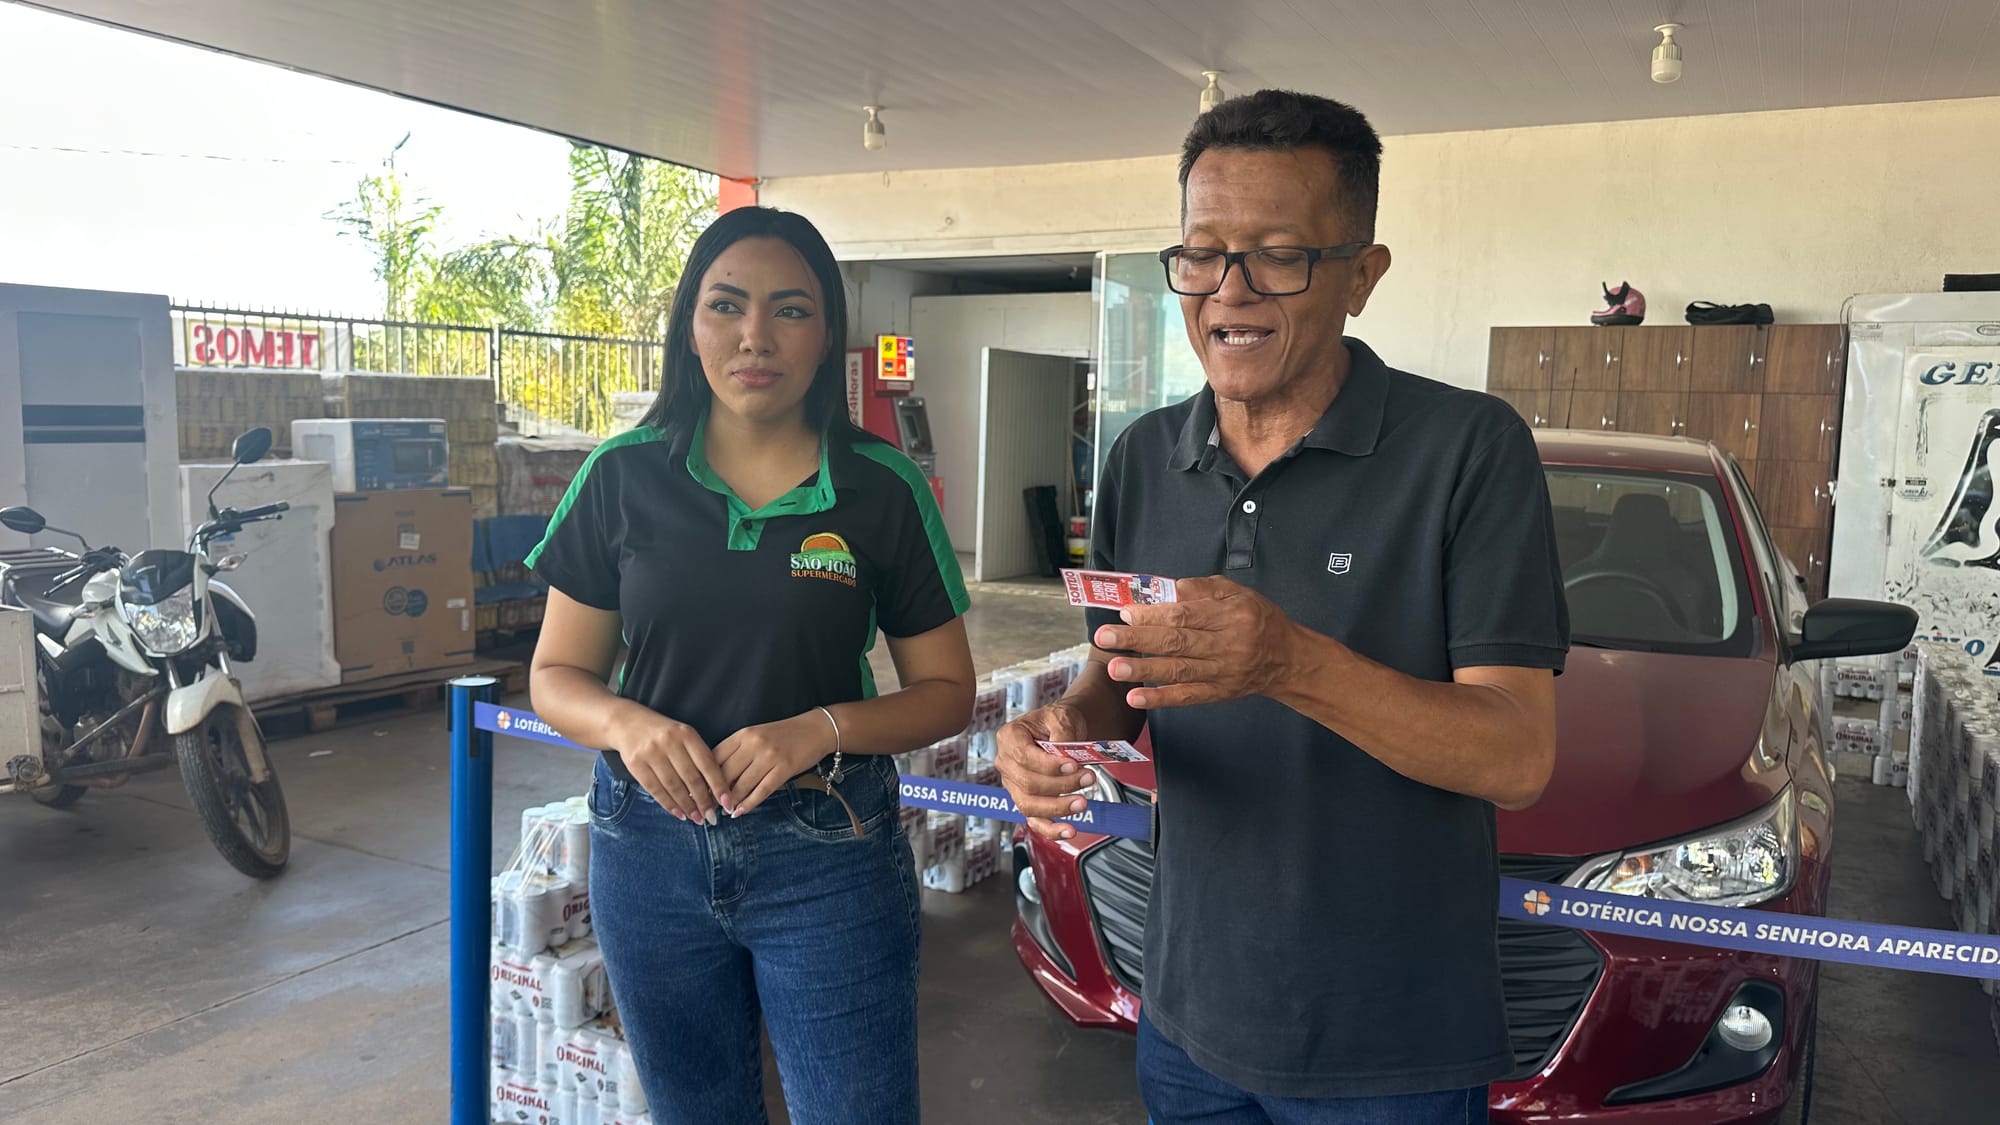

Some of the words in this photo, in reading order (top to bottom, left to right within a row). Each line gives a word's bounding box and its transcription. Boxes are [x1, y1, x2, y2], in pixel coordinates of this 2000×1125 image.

[1919, 361, 2000, 385] GE
[387, 553, 438, 567] ATLAS
[790, 553, 823, 570] SÃO
[825, 559, 857, 579] JOÃO
[791, 569, 857, 588] SUPERMERCADO
[1090, 580, 1106, 602] CARRO
[1104, 582, 1121, 603] ZERO
[940, 790, 1009, 813] SENHORA
[1560, 899, 1663, 927] LOTÉRICA
[1669, 914, 1748, 937] NOSSA
[1754, 923, 1870, 951] SENHORA
[1876, 938, 2000, 964] APARECID
[491, 964, 543, 992] ORIGINAL
[556, 1045, 608, 1076] ORIGINAL
[496, 1085, 551, 1111] ORIGINAL
